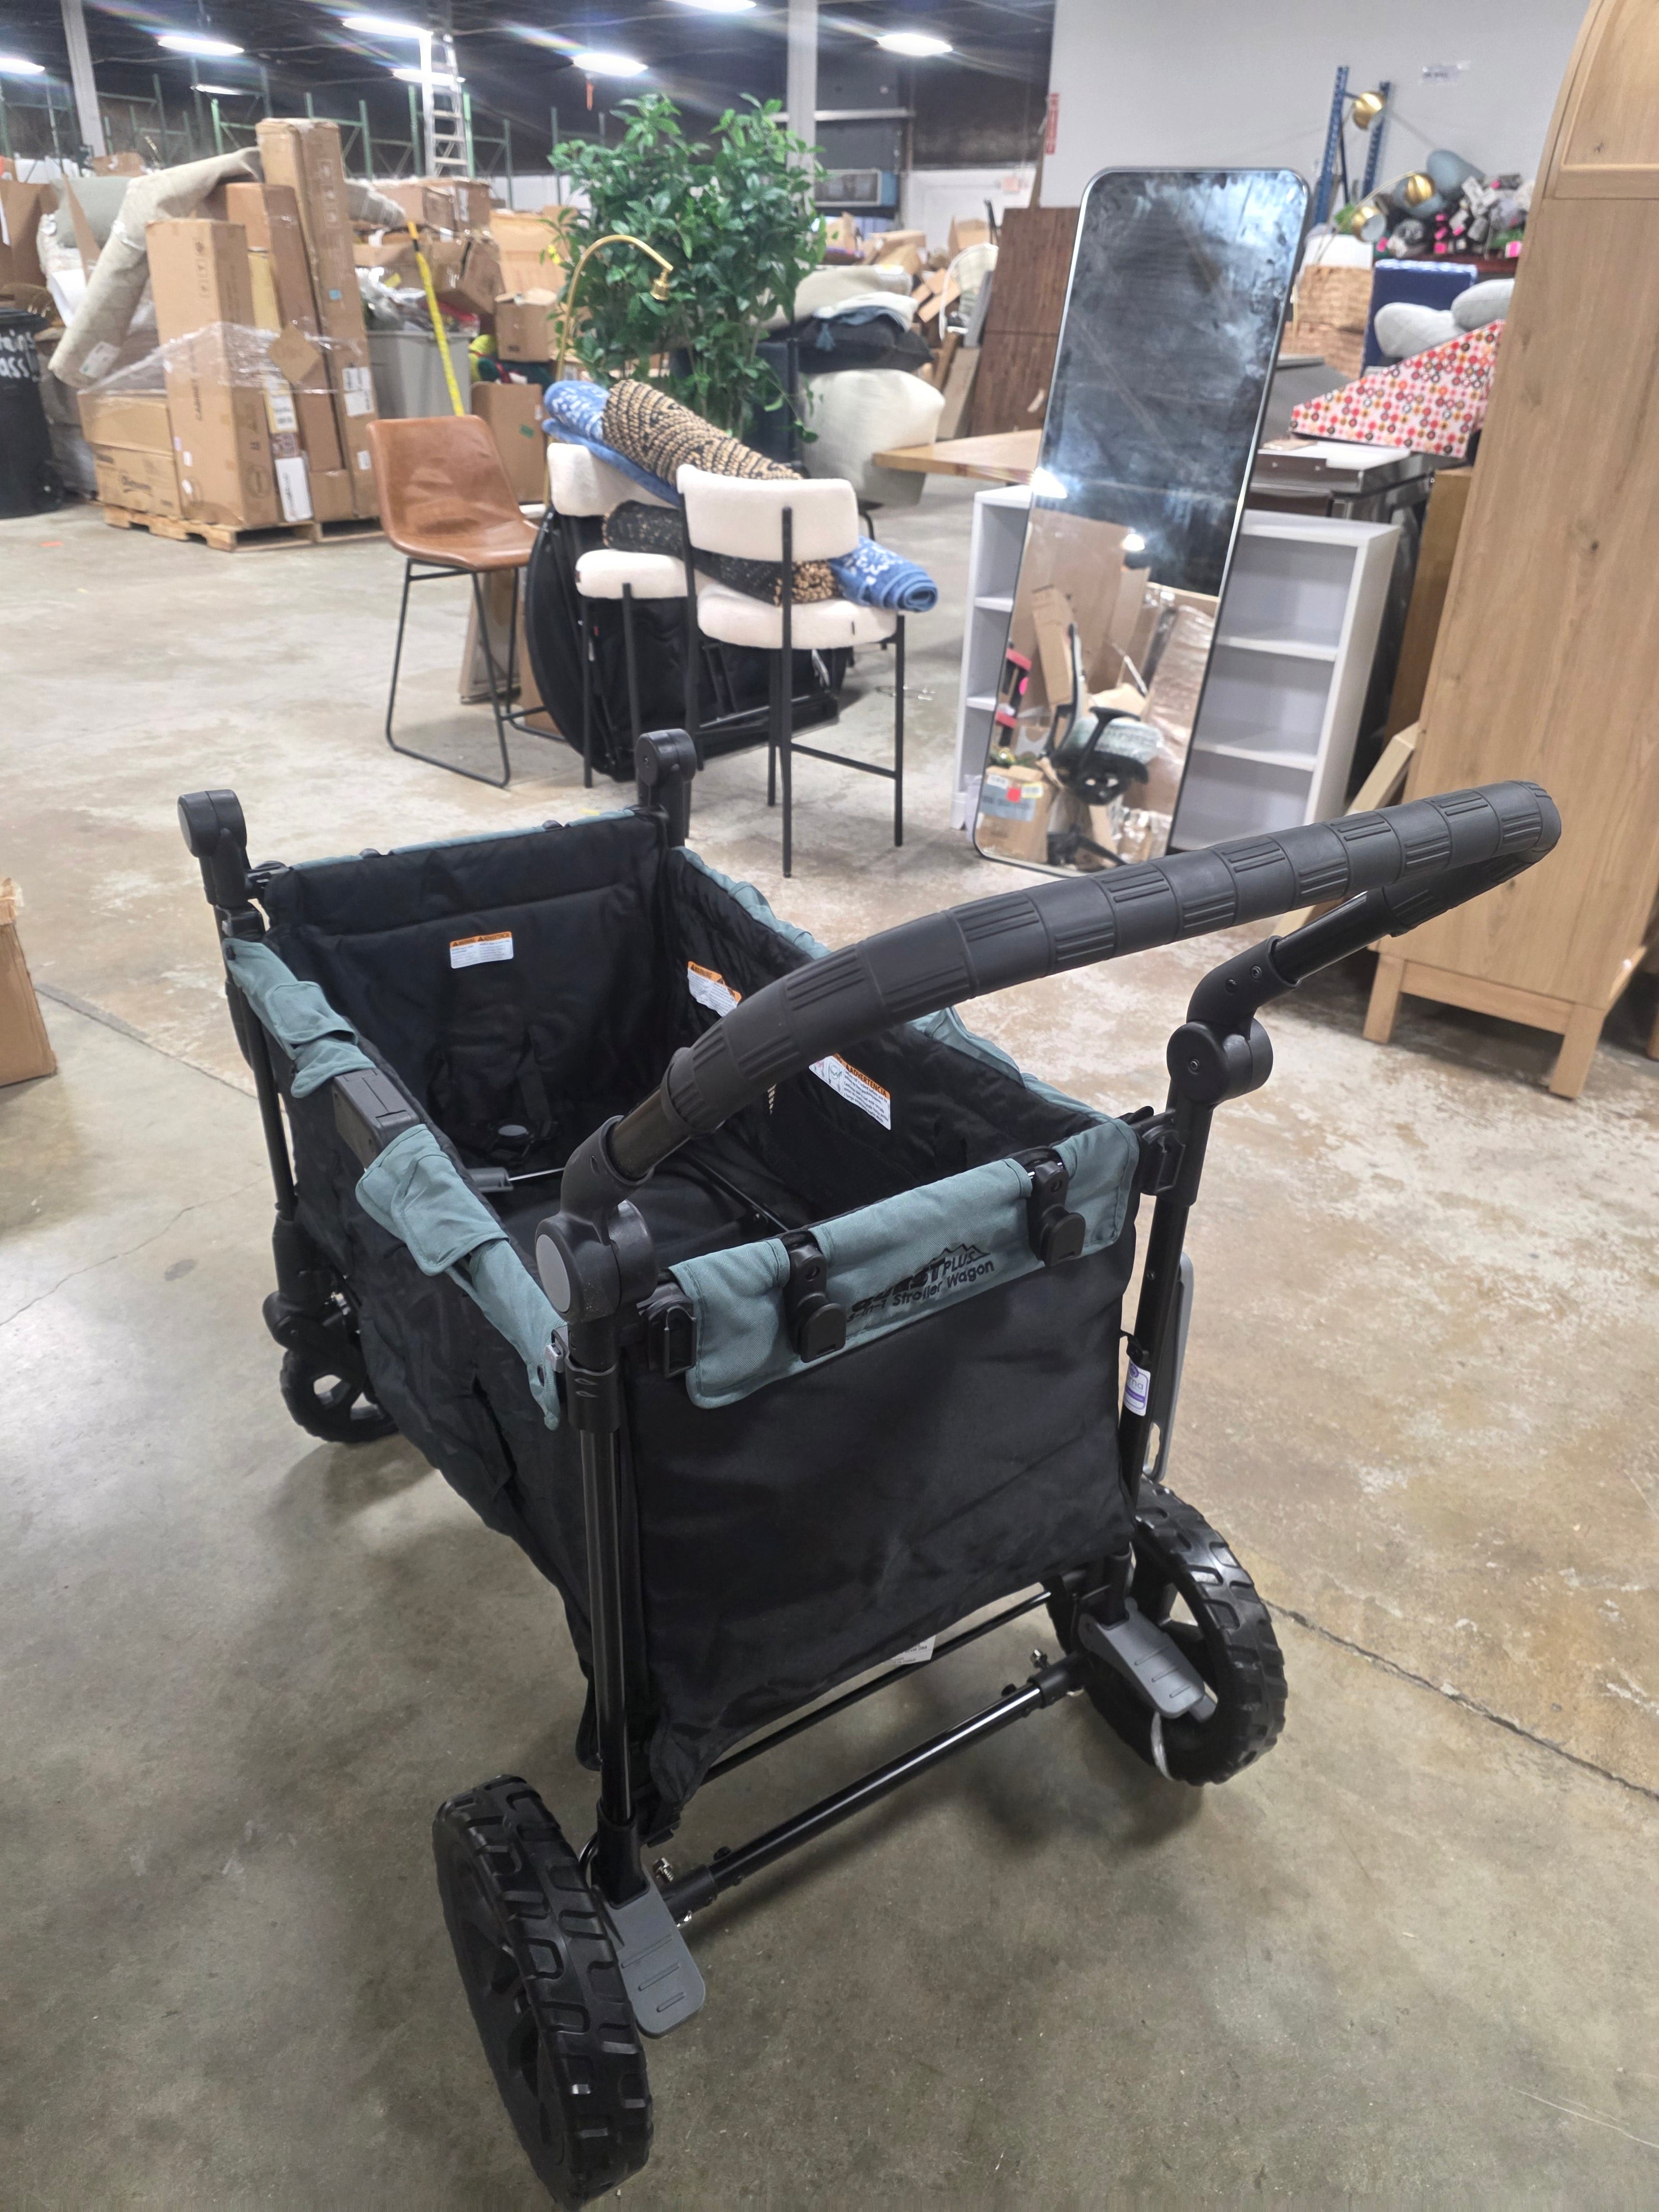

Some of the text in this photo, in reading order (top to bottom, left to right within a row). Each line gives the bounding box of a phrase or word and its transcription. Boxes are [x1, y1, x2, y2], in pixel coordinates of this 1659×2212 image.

[850, 1067, 887, 1098] ADVERTENCIA
[942, 1251, 977, 1276] PLUS
[892, 1281, 943, 1306] Stroller
[947, 1260, 995, 1288] Wagon
